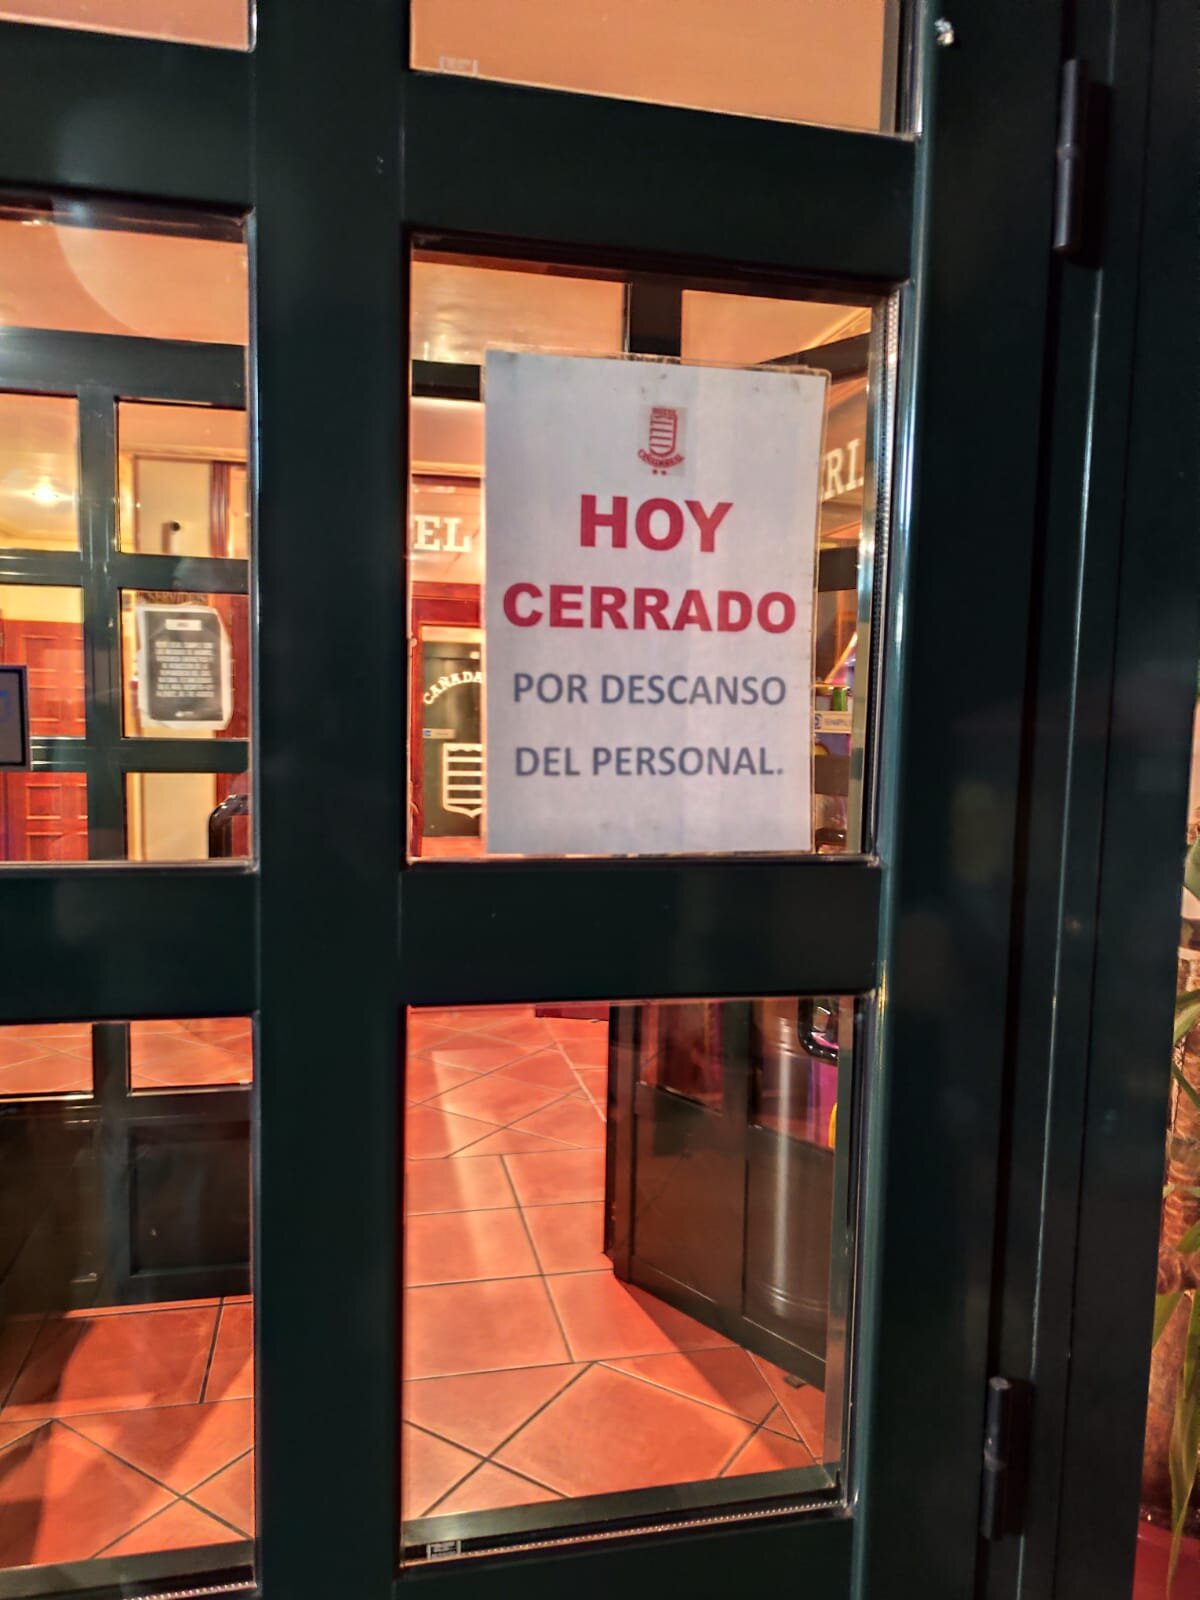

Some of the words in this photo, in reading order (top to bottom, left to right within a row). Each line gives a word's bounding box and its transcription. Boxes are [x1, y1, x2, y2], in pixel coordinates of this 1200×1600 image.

[580, 493, 733, 553] HOY
[503, 582, 797, 634] CERRADO
[513, 672, 589, 704] POR
[601, 674, 787, 705] DESCANSO
[515, 746, 580, 777] DEL
[592, 746, 784, 776] PERSONAL.
